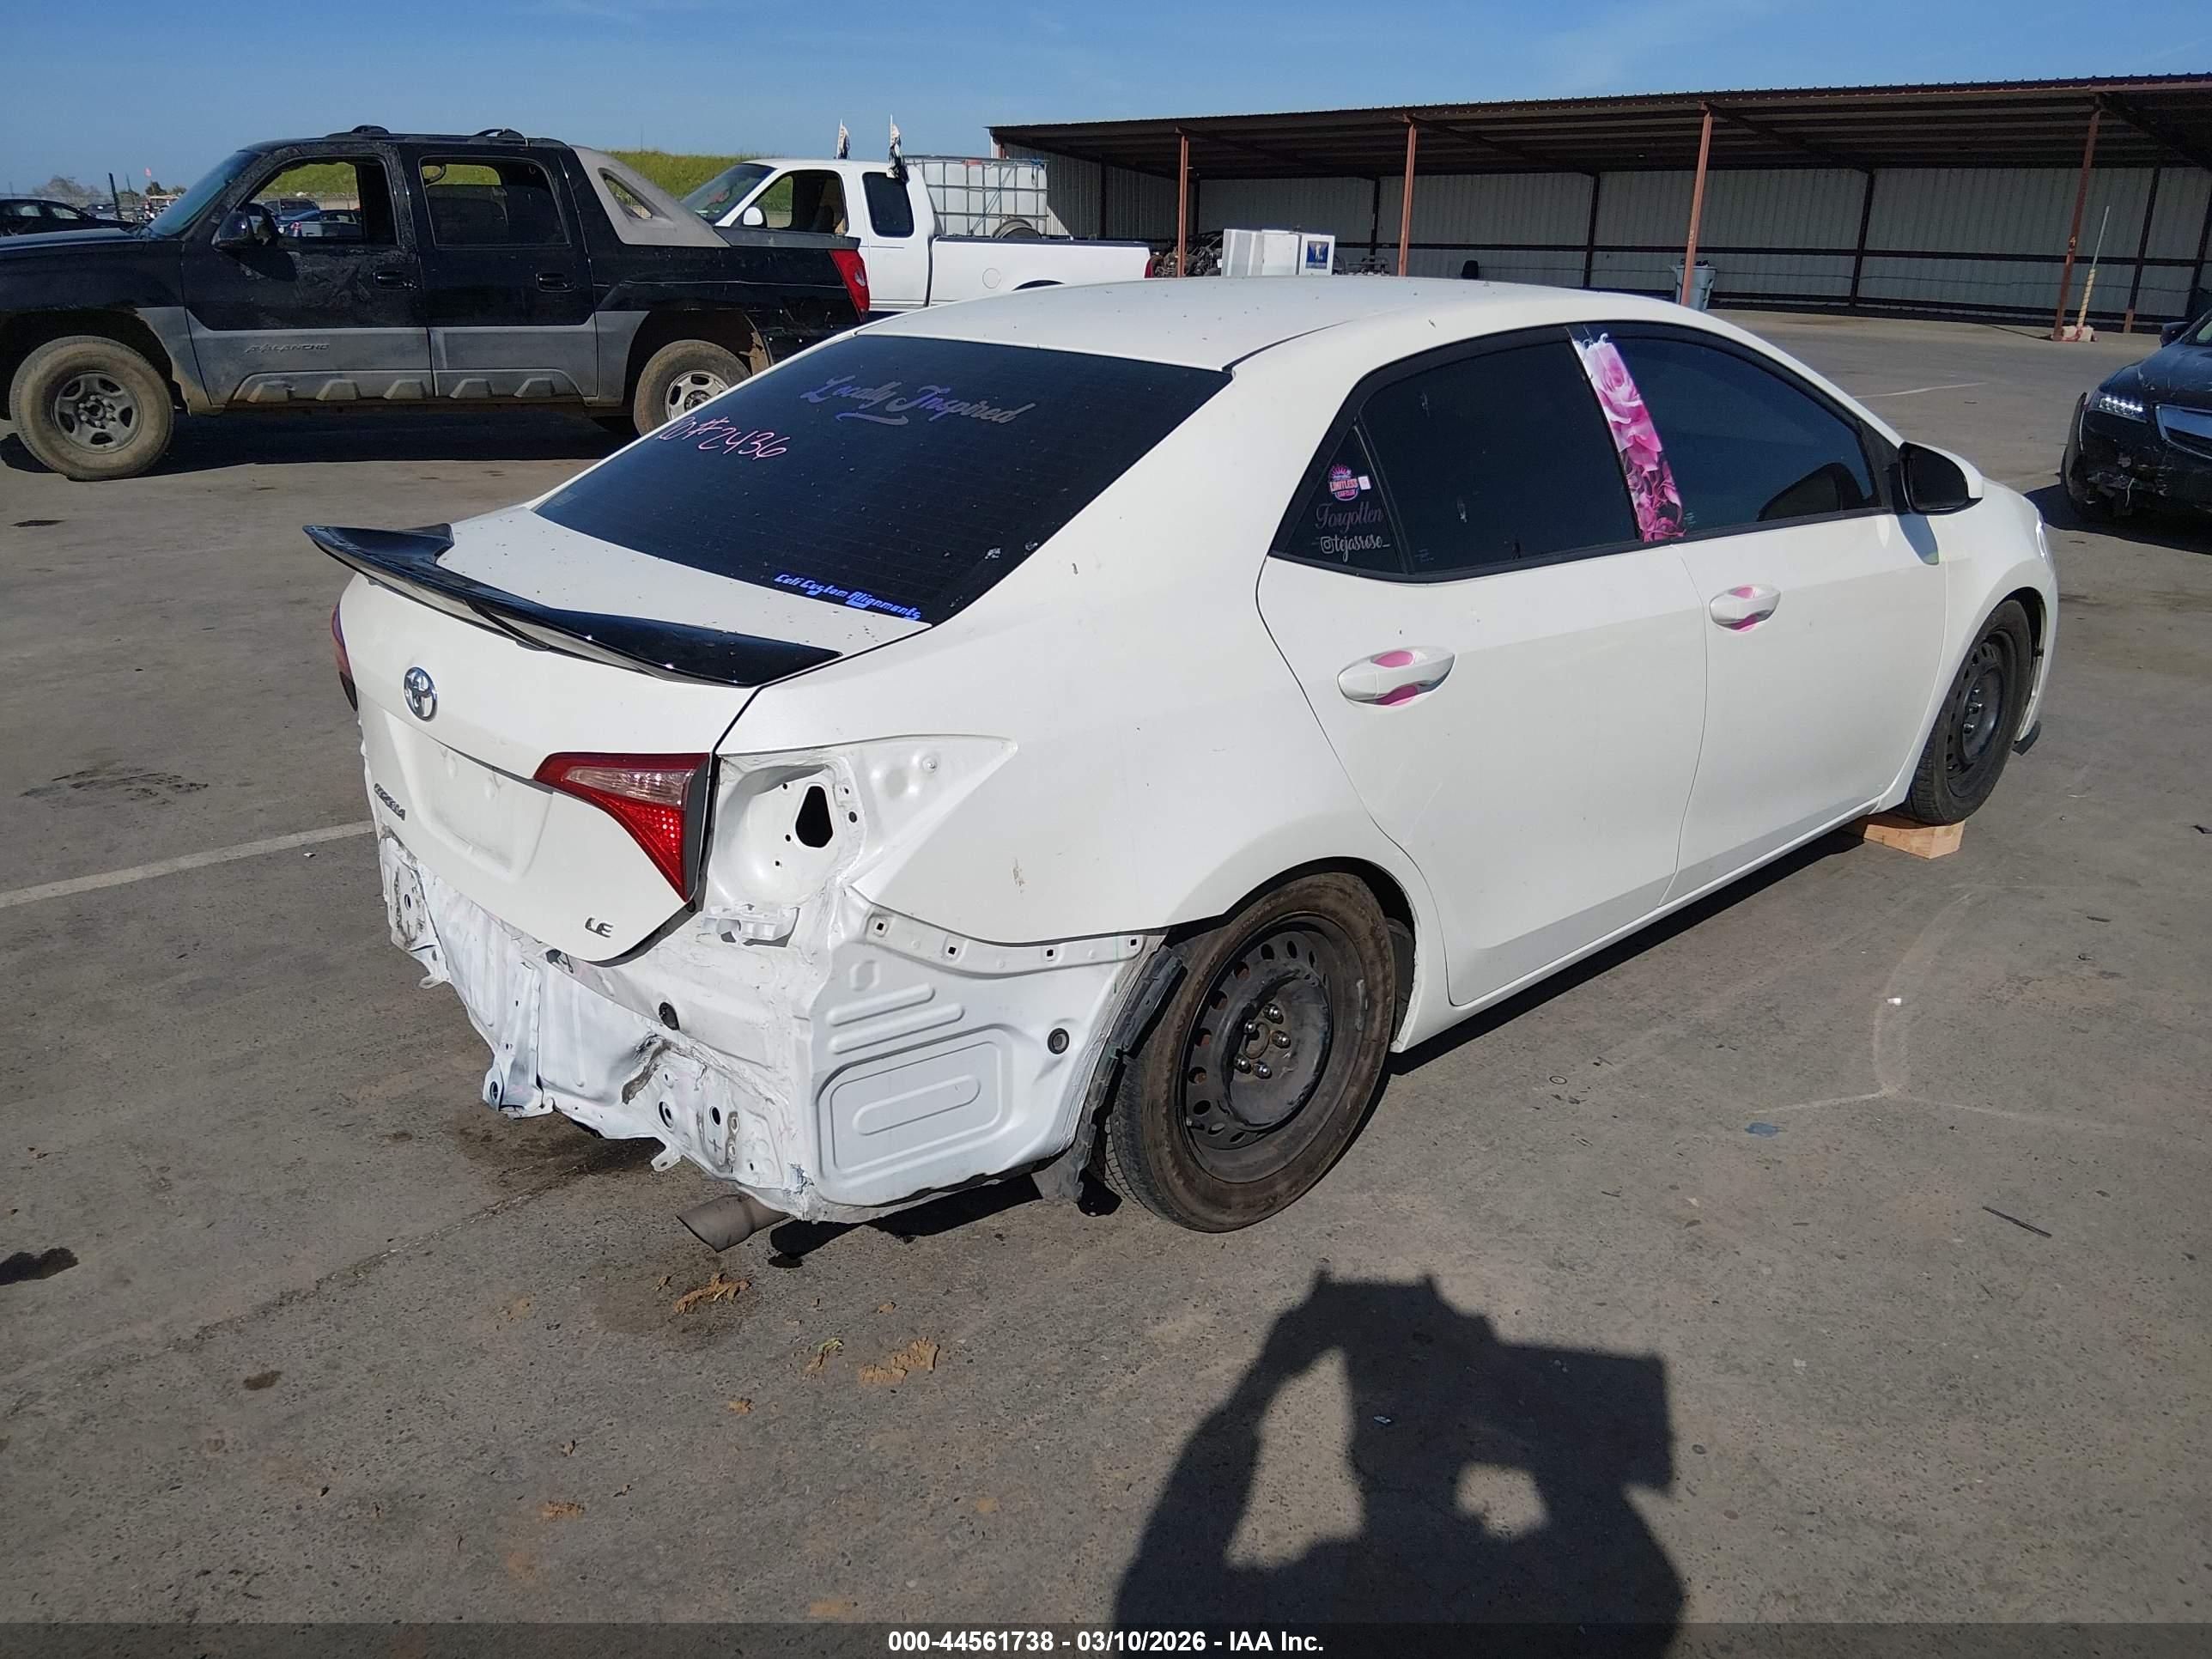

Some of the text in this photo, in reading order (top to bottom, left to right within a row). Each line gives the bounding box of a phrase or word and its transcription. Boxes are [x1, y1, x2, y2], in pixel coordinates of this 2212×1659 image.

[884, 385, 1036, 424] Inspired
[799, 580, 849, 597] Custom
[845, 592, 922, 621] Alignments
[585, 917, 614, 938] LE
